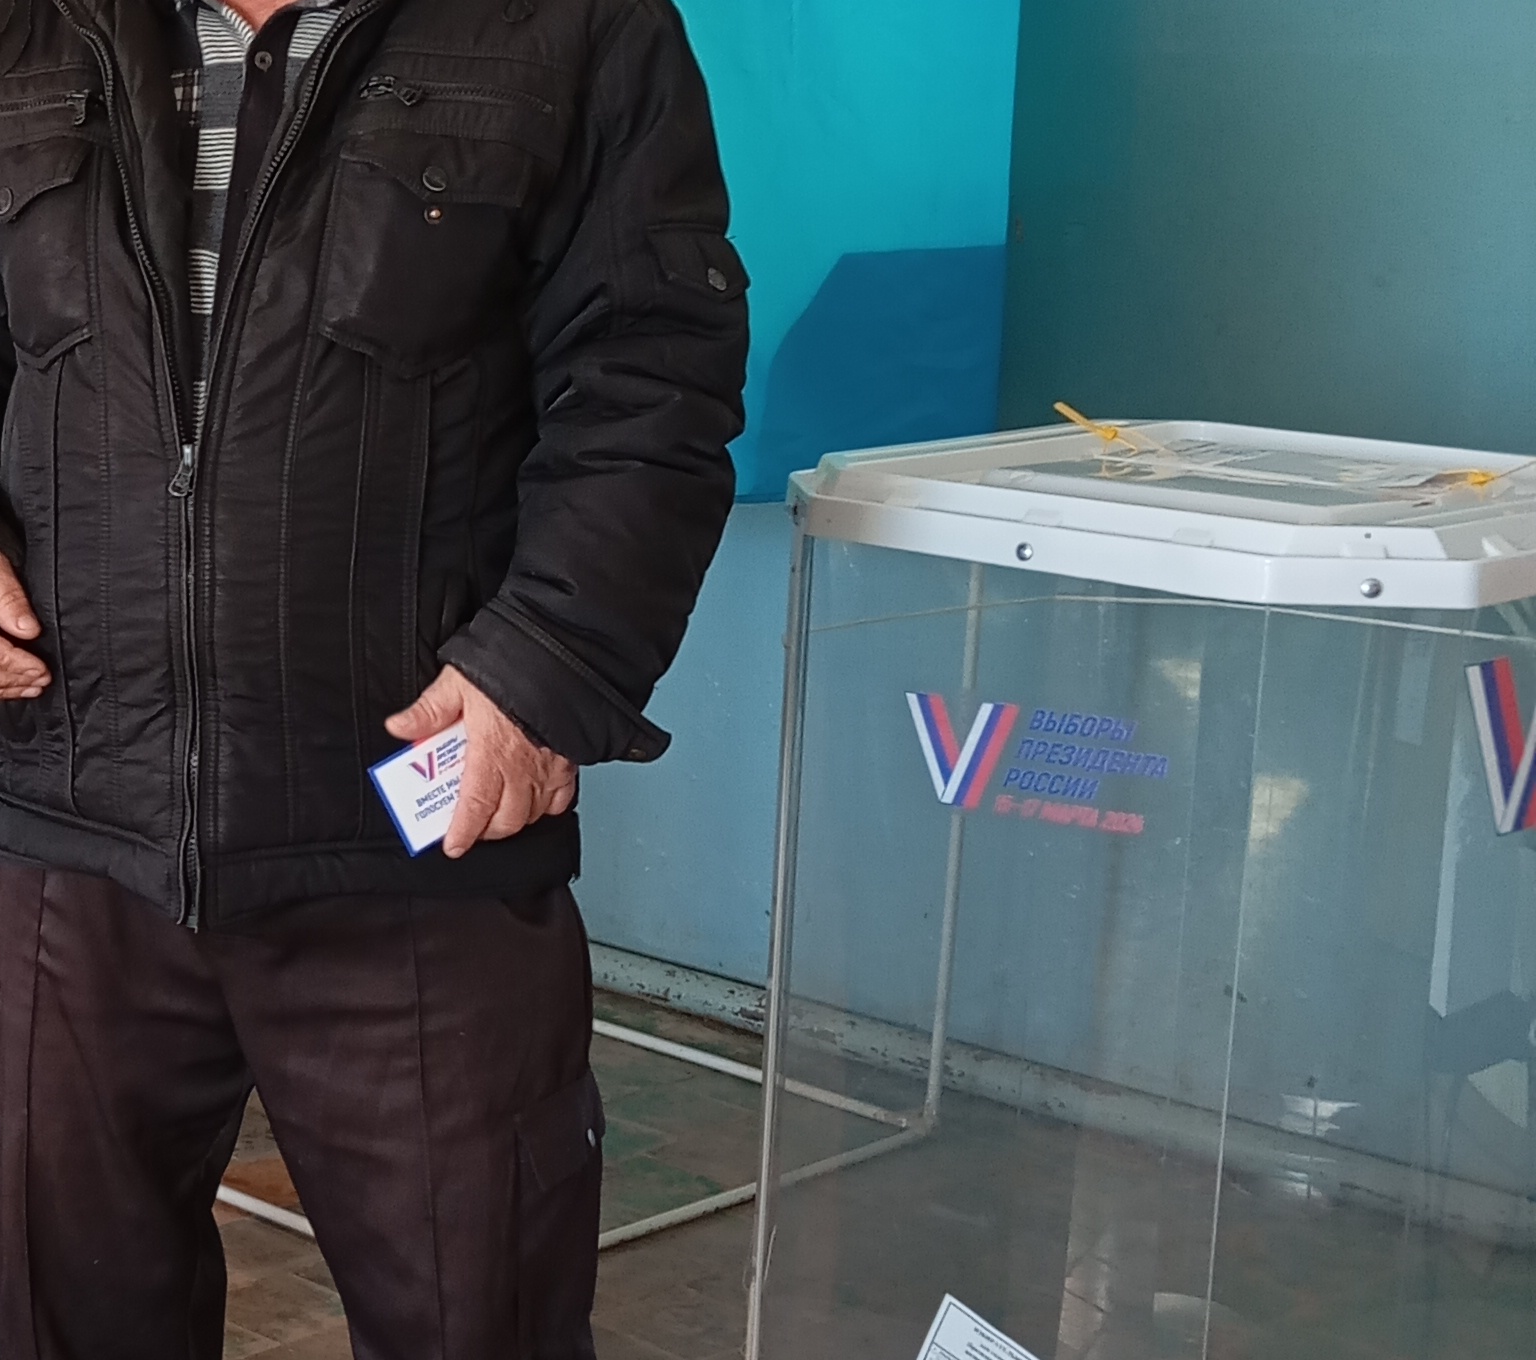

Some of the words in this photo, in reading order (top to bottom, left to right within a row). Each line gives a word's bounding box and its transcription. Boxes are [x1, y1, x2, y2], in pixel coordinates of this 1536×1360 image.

[1028, 709, 1137, 742] ВЫБОРЫ
[1015, 738, 1169, 779] ПРЕЗИДЕНТА
[415, 785, 447, 807] ВМЕСТЕ
[445, 775, 461, 790] МЫ
[1003, 767, 1101, 800] РОССИИ
[414, 793, 456, 822] ГОЛОСУЕМ
